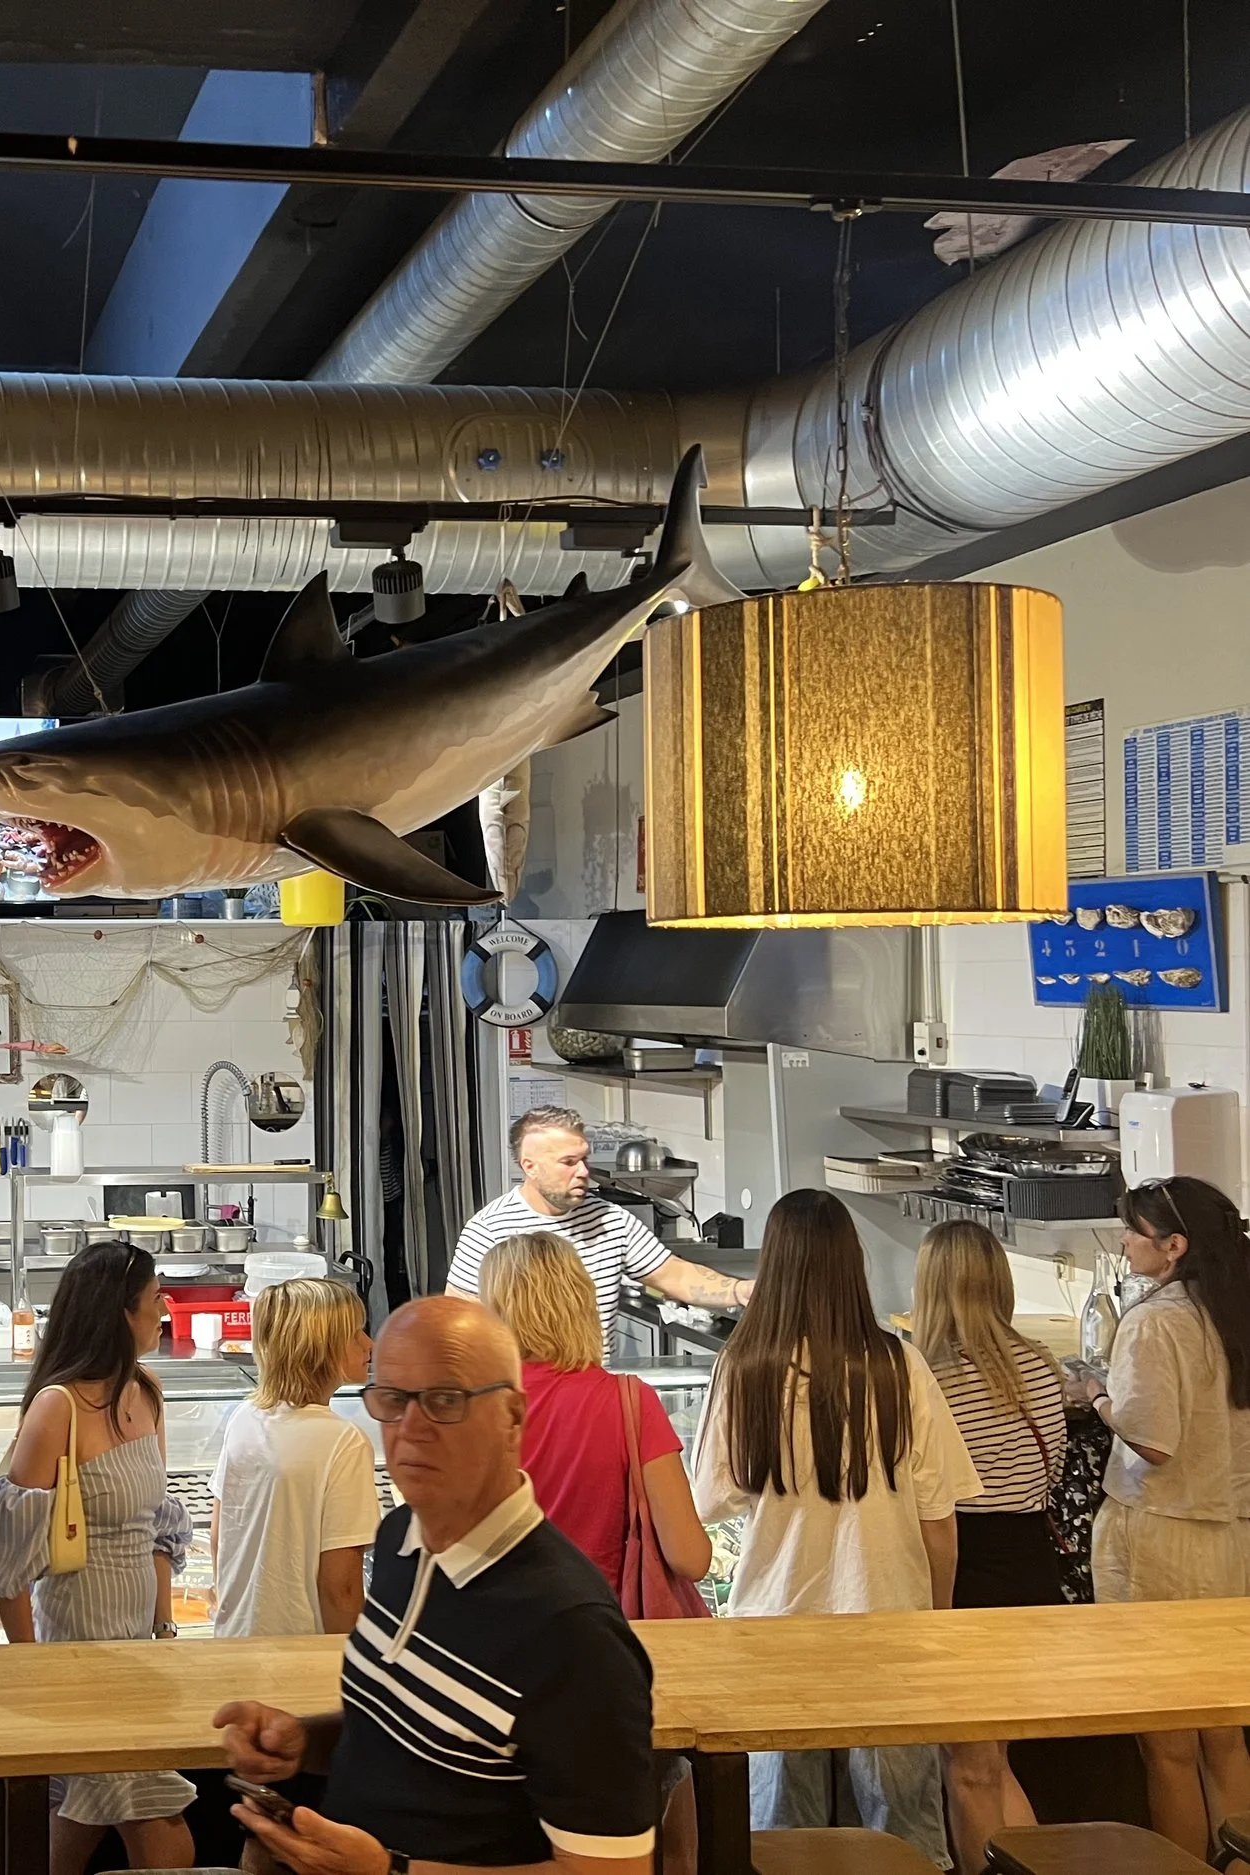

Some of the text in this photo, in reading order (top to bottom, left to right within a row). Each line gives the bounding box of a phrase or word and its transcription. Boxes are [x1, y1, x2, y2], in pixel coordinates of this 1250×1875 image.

[488, 935, 529, 946] WELCOME
[490, 1008, 533, 1021] ON BOARD
